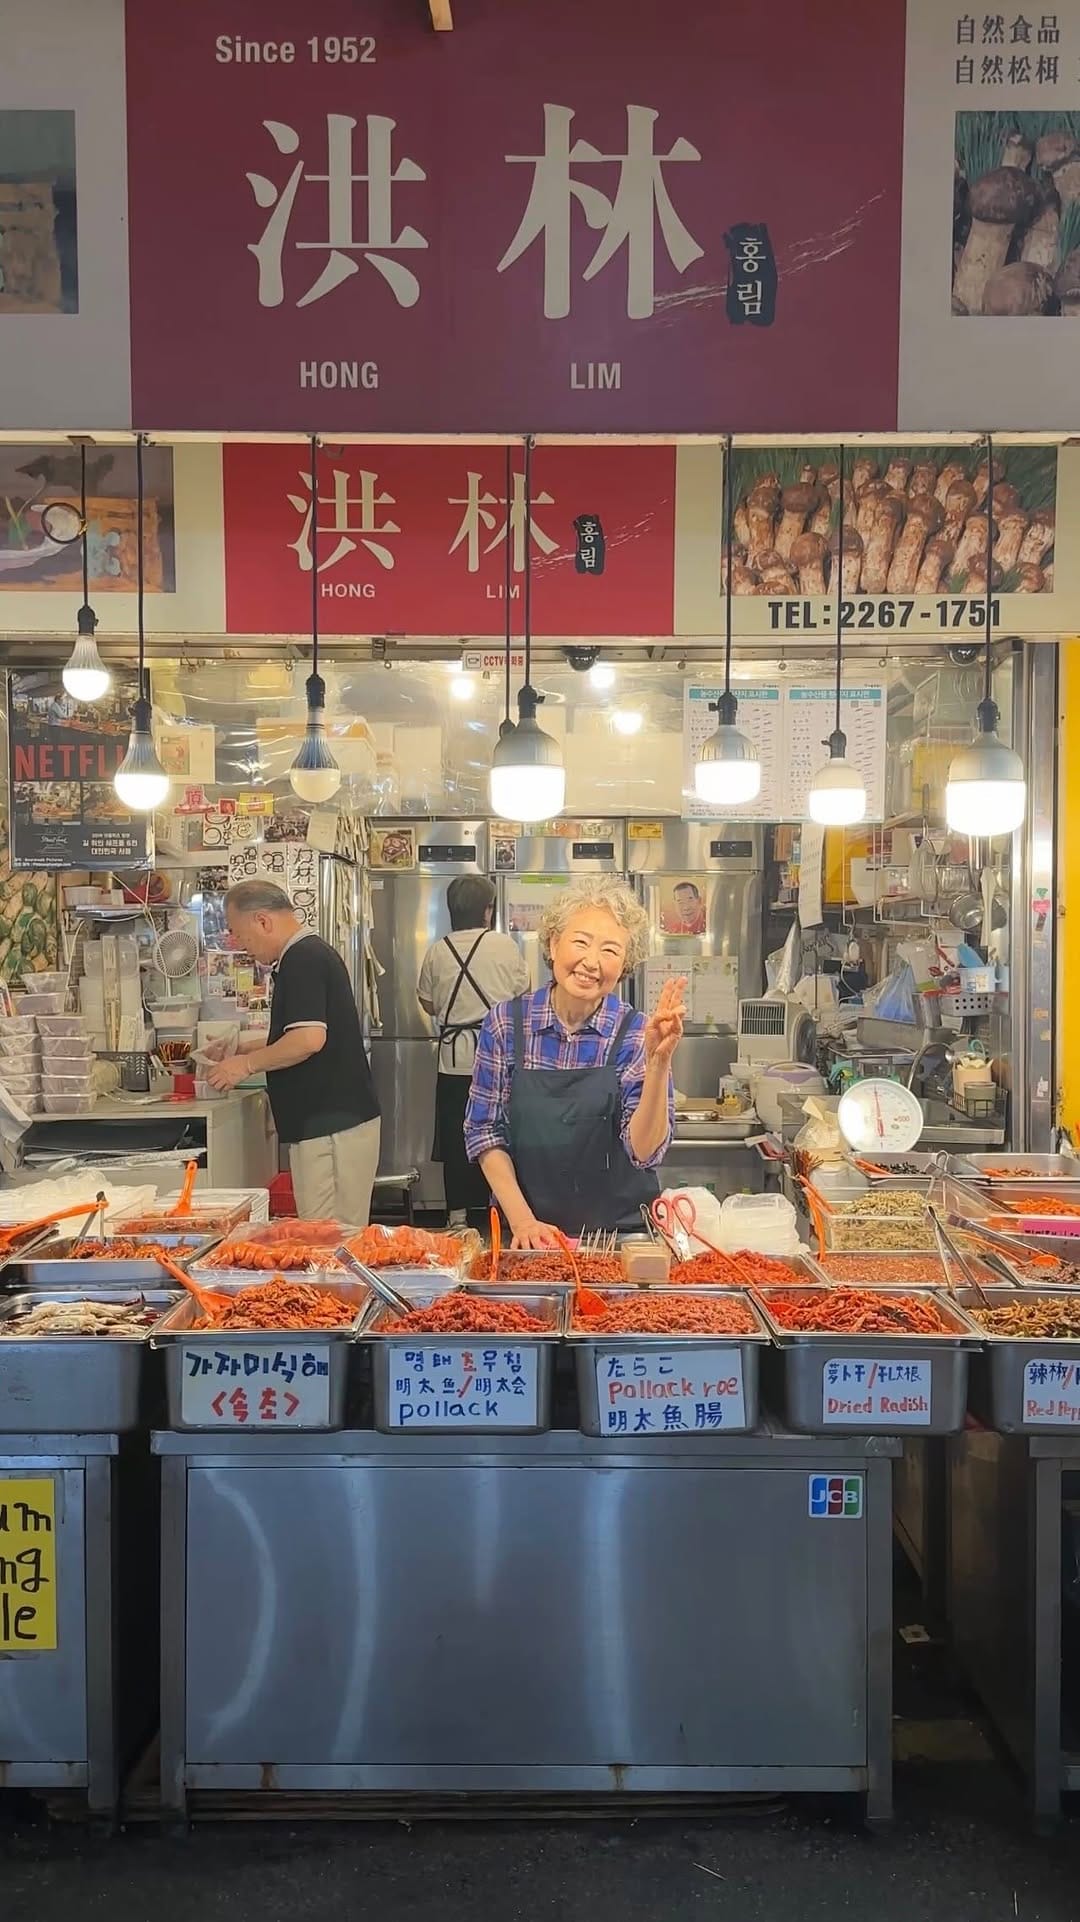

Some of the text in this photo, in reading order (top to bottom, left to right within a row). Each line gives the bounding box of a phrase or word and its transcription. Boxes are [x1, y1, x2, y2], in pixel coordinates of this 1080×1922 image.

[957, 14, 1060, 44] 自然食品
[215, 35, 377, 64] Since 1952
[245, 103, 705, 321] 洪林
[735, 237, 766, 316] 홍림
[299, 360, 622, 390] HONG LIM
[287, 469, 560, 573] 洪林
[579, 521, 599, 568] 홍림
[321, 583, 521, 599] HONG LIM
[15, 743, 125, 781] NETFLI
[185, 1351, 329, 1384] 가자미식해
[607, 1356, 674, 1378] たらこ
[703, 1376, 739, 1397] roe
[399, 1400, 499, 1425] pollack
[827, 1396, 873, 1414] Dried
[1027, 1399, 1055, 1417] Red
[811, 1489, 858, 1504] JCB
[0, 1548, 50, 1593] ng
[2, 1592, 38, 1641] le
